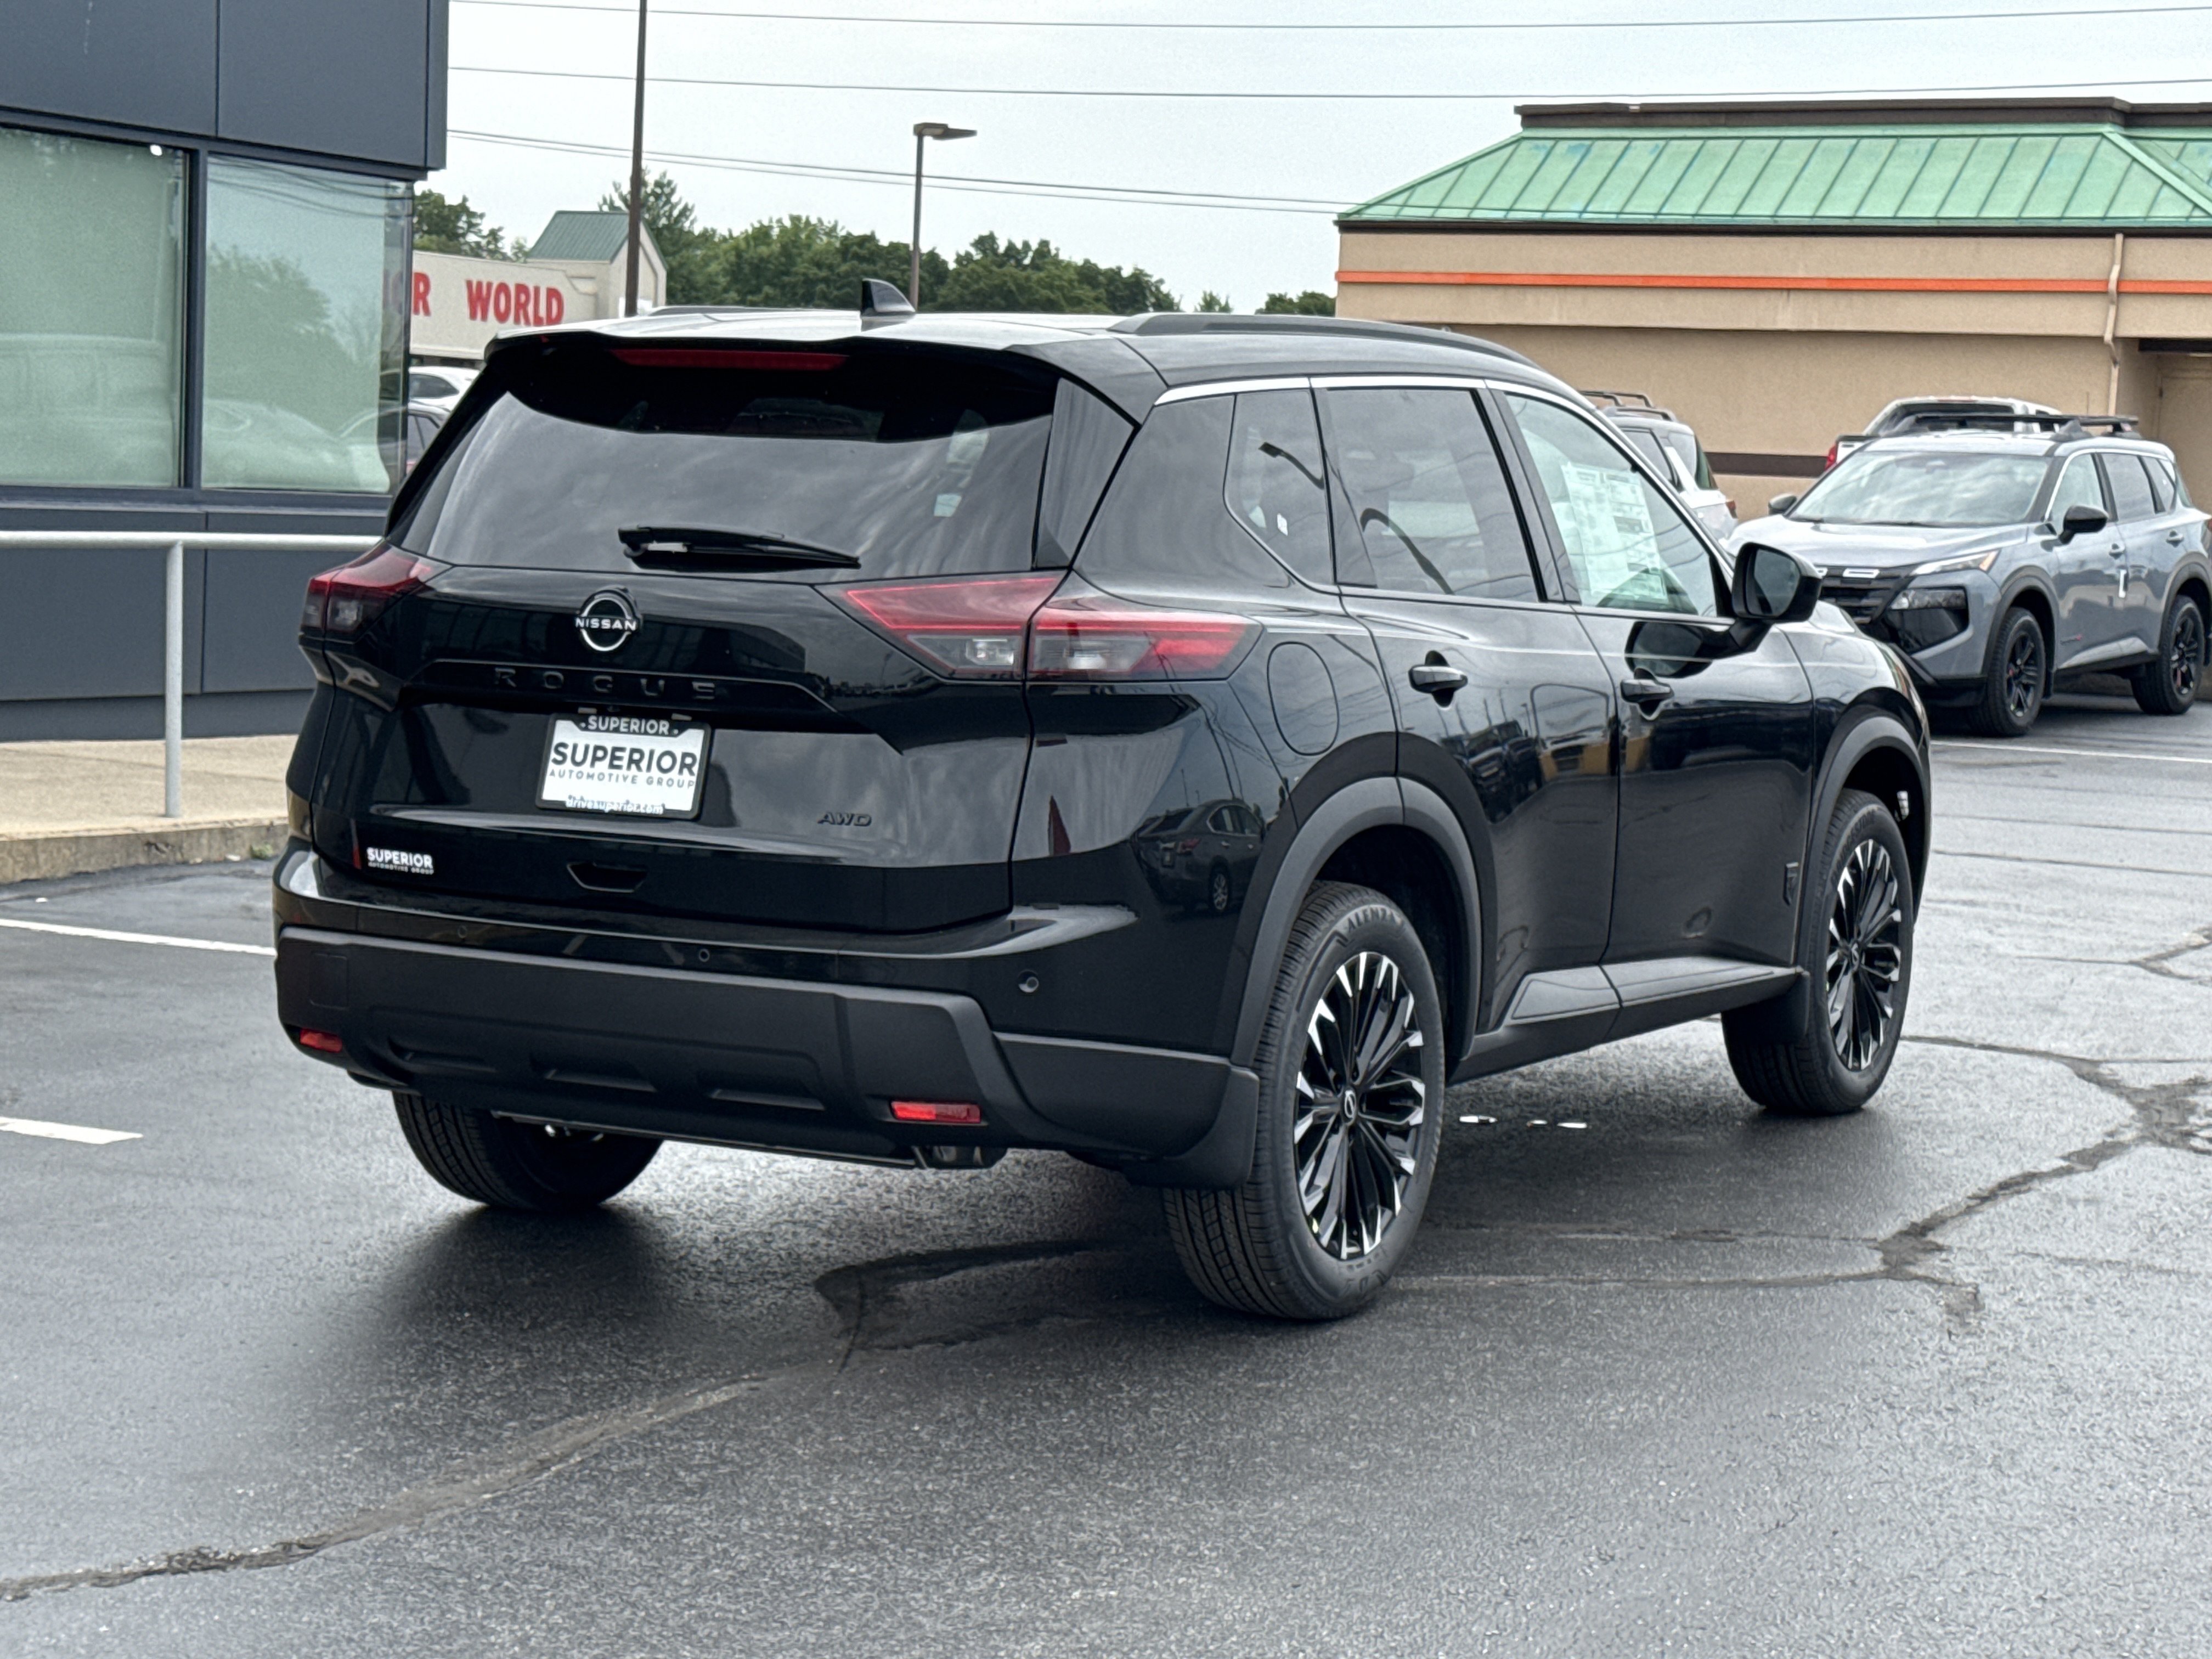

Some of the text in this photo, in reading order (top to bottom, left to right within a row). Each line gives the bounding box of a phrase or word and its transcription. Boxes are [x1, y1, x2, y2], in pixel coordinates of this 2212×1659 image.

[466, 279, 564, 326] WORLD
[575, 617, 637, 631] NISSAN
[494, 667, 715, 699] ROGUE
[587, 715, 670, 735] SUPERIOR
[551, 742, 698, 777] SUPERIOR
[549, 769, 695, 789] AUTOMOTIVE GROUP
[817, 811, 872, 827] AWD
[366, 847, 433, 868] SUPERIOR
